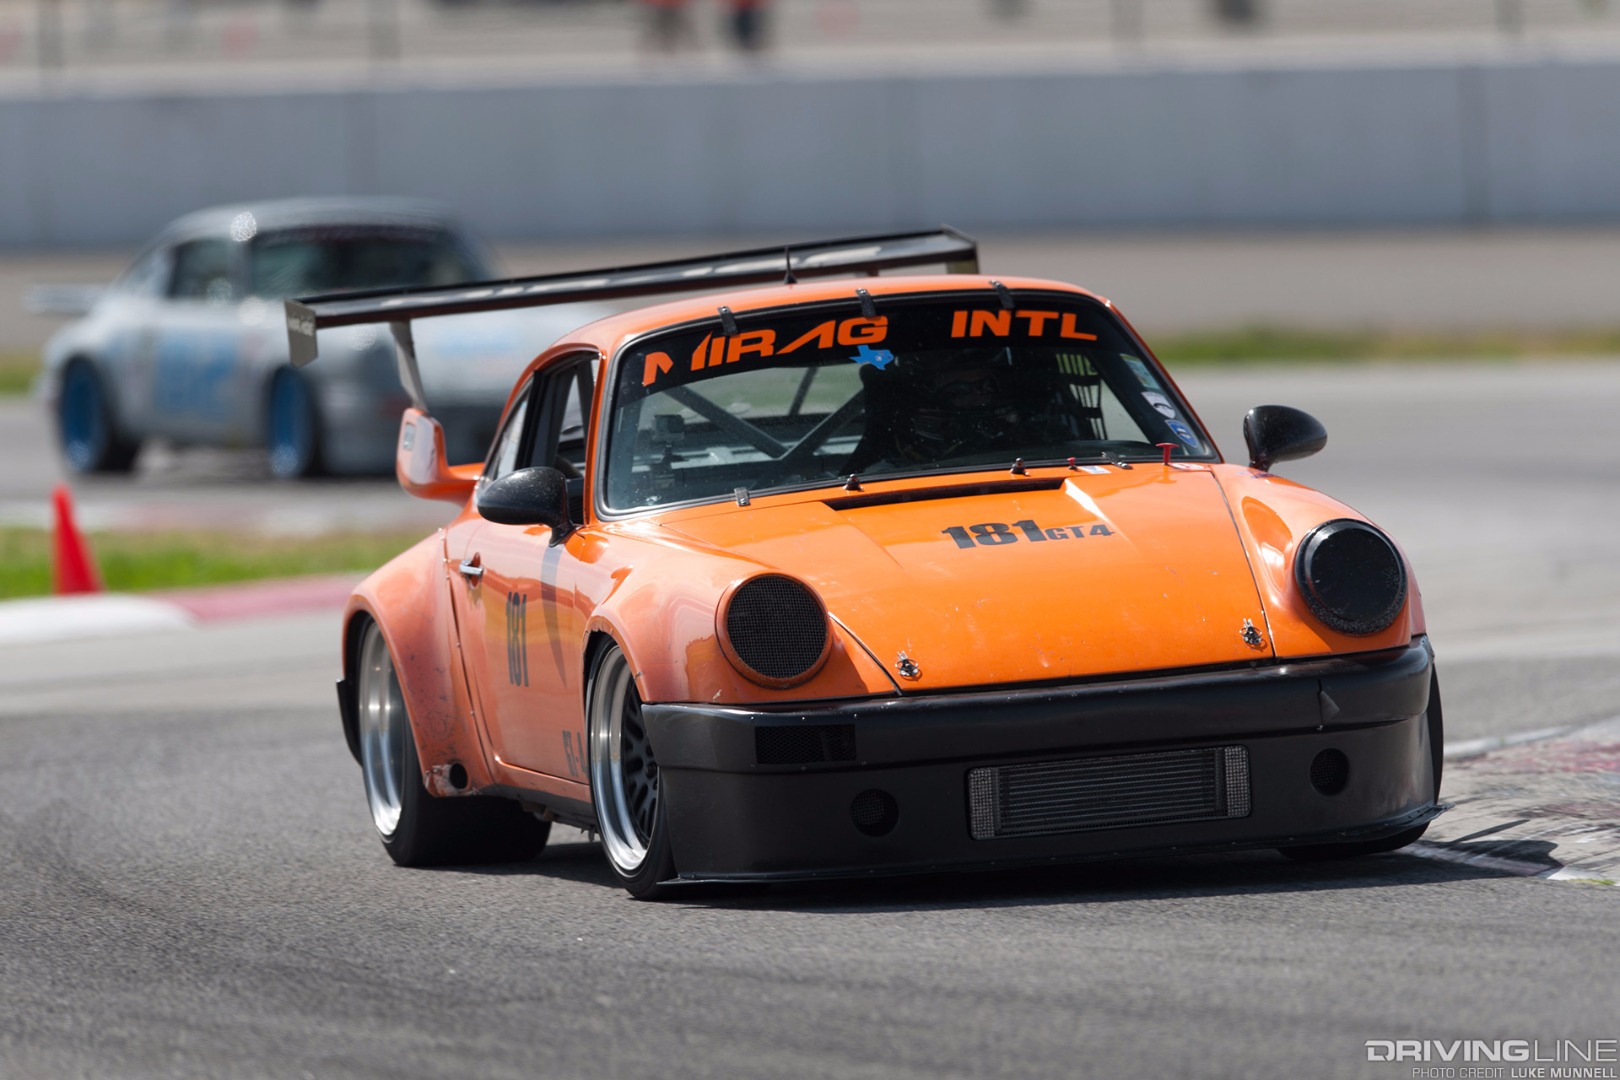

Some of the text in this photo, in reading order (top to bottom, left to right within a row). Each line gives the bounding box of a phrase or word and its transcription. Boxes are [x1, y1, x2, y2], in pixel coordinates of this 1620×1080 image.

[951, 310, 1098, 341] INTL
[942, 519, 1116, 549] 181 GT4
[506, 592, 529, 687] 181
